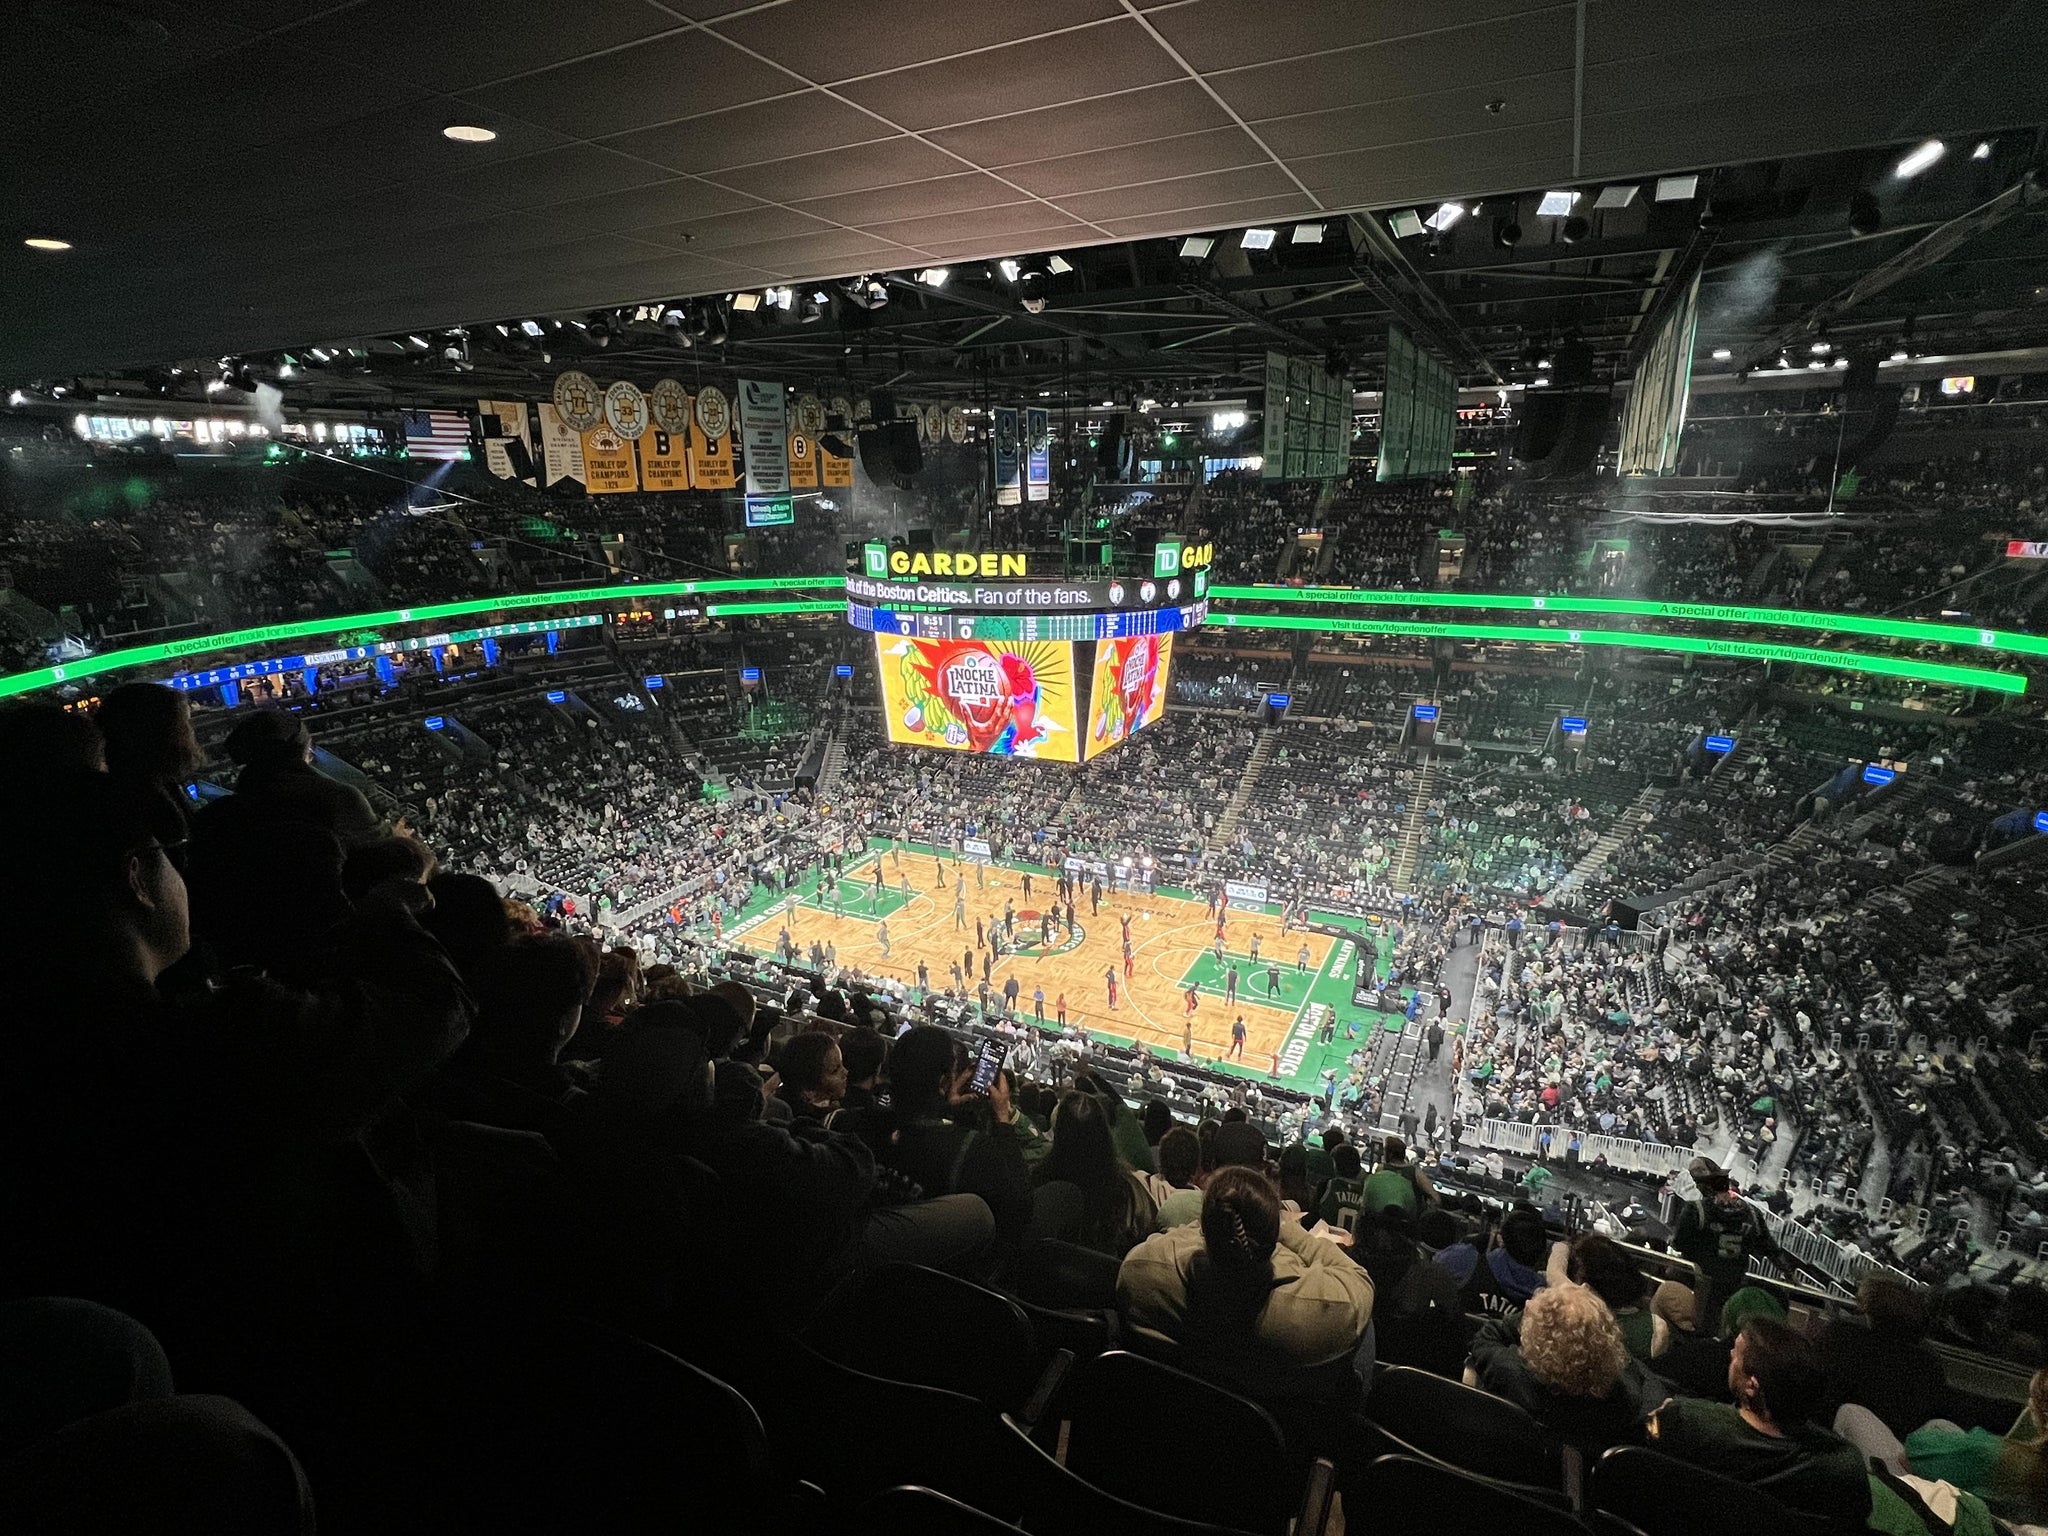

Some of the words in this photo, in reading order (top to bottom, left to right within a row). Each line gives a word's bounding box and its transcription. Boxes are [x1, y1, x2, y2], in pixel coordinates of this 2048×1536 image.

[609, 384, 625, 401] ZDENO
[621, 406, 633, 416] 33
[590, 430, 624, 448] BOSTON
[655, 431, 671, 456] B
[797, 440, 804, 454] B
[706, 439, 719, 456] B
[590, 460, 615, 469] STANLEY
[616, 460, 627, 469] CUP
[648, 460, 670, 469] STANLEY
[698, 460, 719, 468] STANLEY
[591, 470, 630, 479] CHAMPIONS
[648, 469, 682, 478] CHAMPIONS
[699, 469, 729, 477] CHAMPIONS
[865, 550, 887, 572] TD
[890, 550, 1027, 577] GARDEN
[1157, 549, 1178, 571] TD
[782, 579, 806, 588] special
[501, 595, 531, 607] special
[863, 581, 876, 597] the
[876, 582, 916, 601] Boston
[917, 586, 972, 604] Celtics.
[974, 588, 1003, 604] Fan
[1006, 588, 1023, 605] of
[1025, 589, 1052, 605] the
[1054, 588, 1092, 604] fans.
[1296, 590, 1304, 599] A
[1305, 590, 1338, 601] special
[1366, 592, 1393, 602] made
[1395, 593, 1408, 602] for
[923, 615, 943, 626] 8:51
[1659, 604, 1669, 614] A
[1671, 606, 1715, 618] special
[1717, 608, 1750, 620] offer,
[1753, 611, 1790, 622] made
[1792, 612, 1809, 622] for
[901, 621, 910, 635] 0
[960, 625, 972, 640] 0
[1331, 620, 1350, 629] Visit
[1352, 621, 1447, 635] td.com/tdgardenoffer
[163, 645, 172, 656] A
[173, 635, 210, 653] special
[239, 629, 265, 642] made
[266, 625, 281, 637] for
[1706, 642, 1731, 652] Visit
[1734, 643, 1860, 668] td.com/tdgardenoffer
[954, 667, 995, 683] NOCHE
[950, 670, 999, 697] LATINA
[1003, 884, 1061, 897] GADEN
[1112, 903, 1176, 919] GARDEN
[721, 914, 767, 939] BOSTON
[1293, 1000, 1328, 1039] BOSTON
[1277, 1038, 1310, 1077] CELTICS
[1479, 1292, 1519, 1316] TATU
